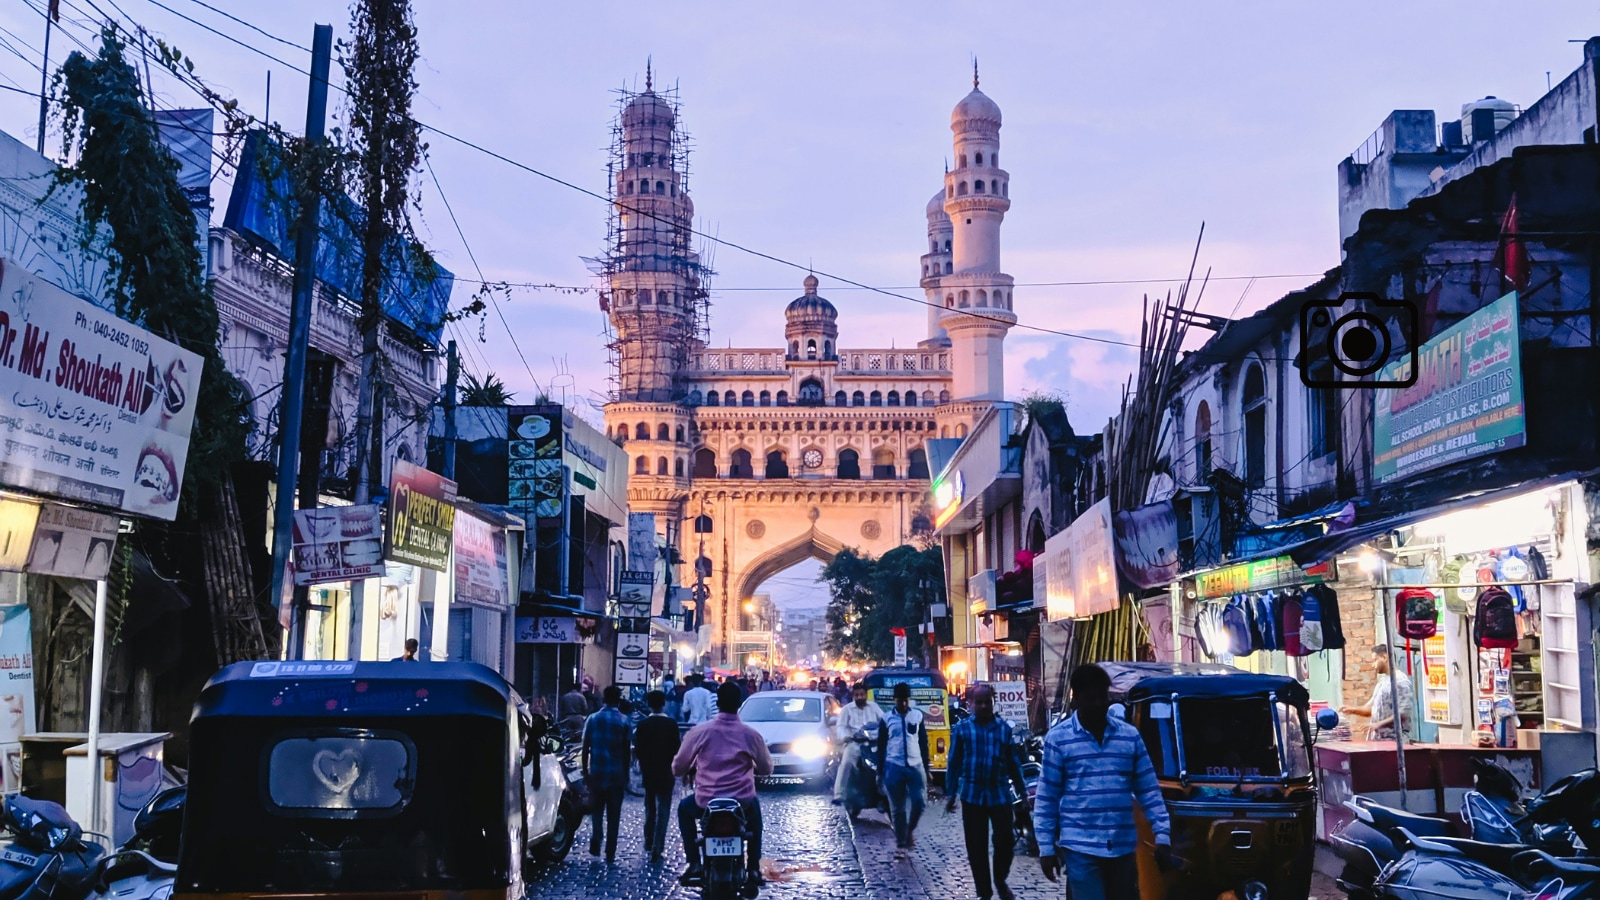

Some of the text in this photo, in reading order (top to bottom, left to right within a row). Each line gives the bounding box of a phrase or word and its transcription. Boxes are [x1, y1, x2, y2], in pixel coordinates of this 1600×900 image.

[75, 311, 87, 329] Ph
[93, 320, 129, 348] 040-2452
[131, 337, 149, 356] 1052
[55, 338, 123, 408] Shoukath
[1442, 367, 1513, 413] DISTRIBUTORS
[1391, 434, 1400, 445] ALL
[1401, 426, 1422, 440] SCHOOL
[1423, 417, 1441, 431] BOOK
[1482, 392, 1510, 410] B.COM
[75, 457, 95, 473] अली
[1396, 447, 1436, 467] WHOLESALE
[1445, 431, 1477, 452] RETAIL
[409, 490, 437, 525] PERFECT
[409, 525, 430, 550] DENTAL
[430, 531, 448, 554] CLINIC
[310, 566, 371, 578] DENTAL CLINIC
[1202, 566, 1250, 598] ZEENATH
[9, 672, 31, 680] Dentist
[994, 691, 1024, 702] EROX
[1206, 766, 1260, 776] FOR HRE
